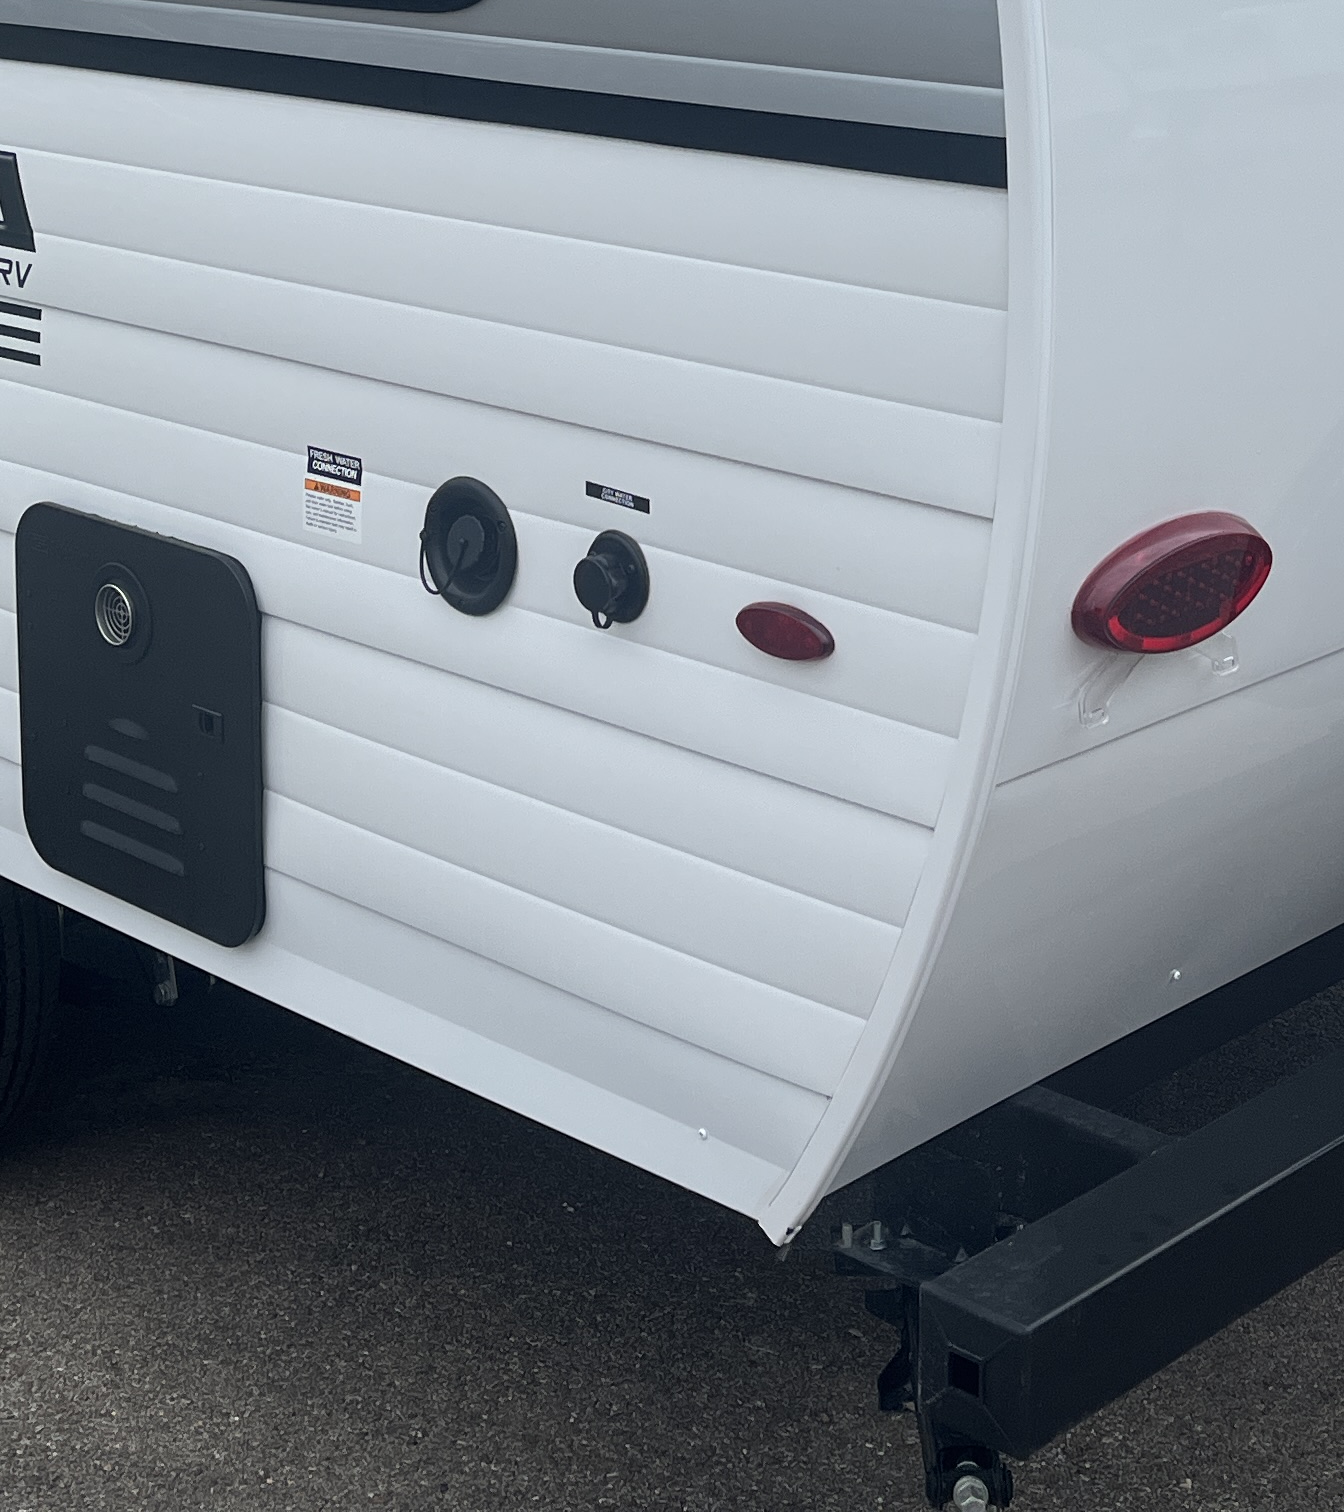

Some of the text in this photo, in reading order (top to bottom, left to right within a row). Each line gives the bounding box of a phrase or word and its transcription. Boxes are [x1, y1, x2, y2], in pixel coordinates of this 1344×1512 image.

[309, 449, 361, 470] FRESH WATER
[312, 460, 358, 480] CONNECTION
